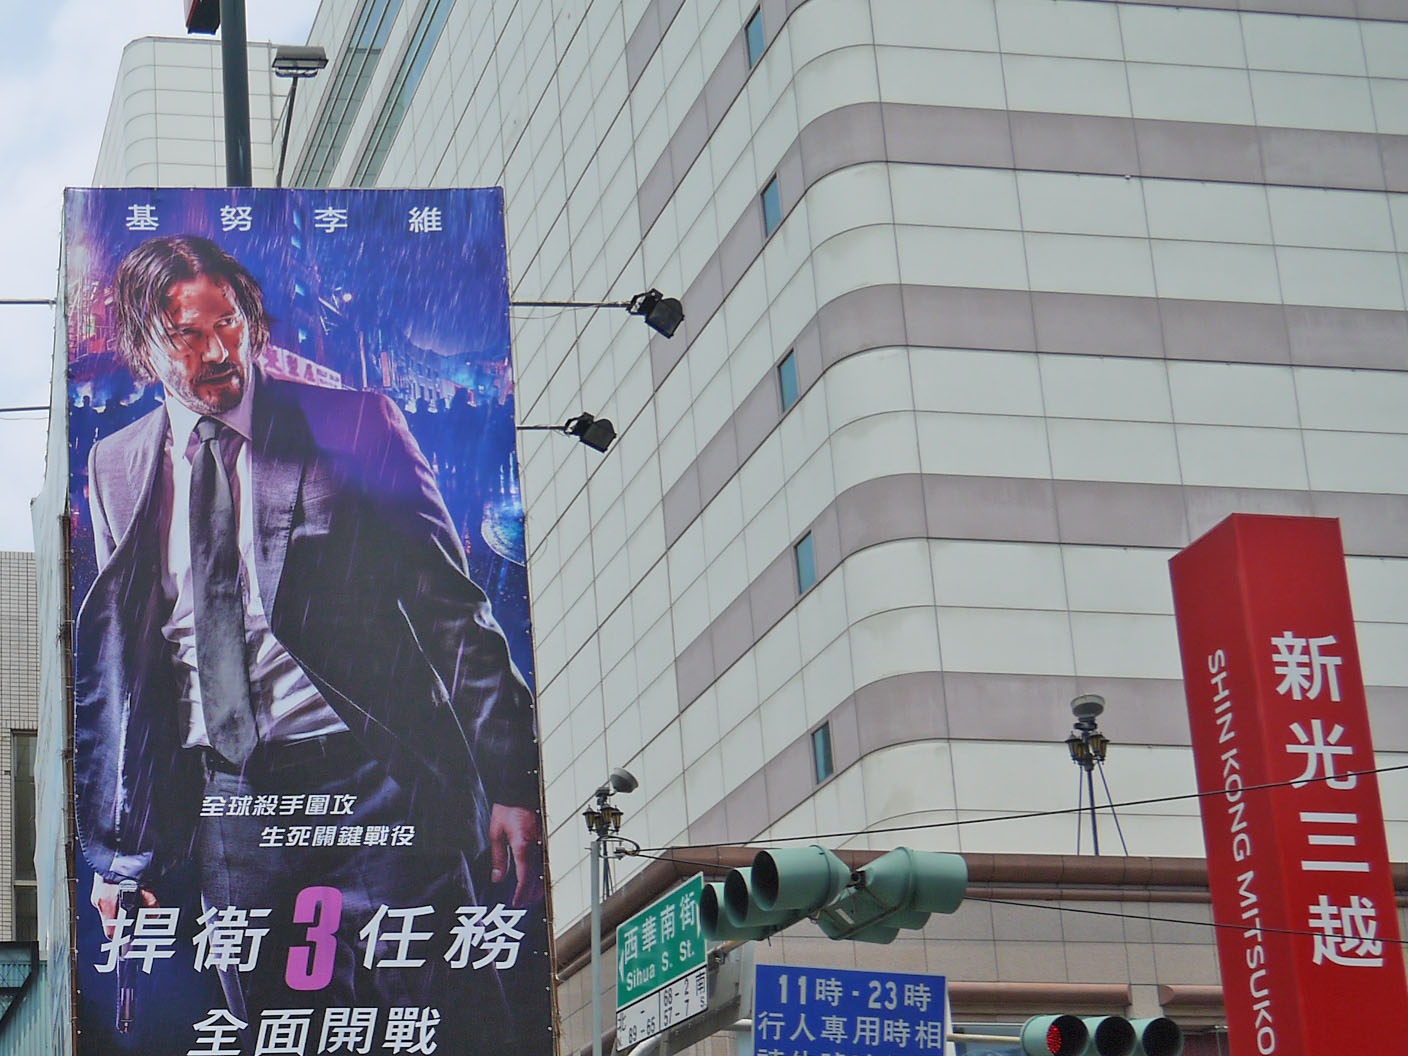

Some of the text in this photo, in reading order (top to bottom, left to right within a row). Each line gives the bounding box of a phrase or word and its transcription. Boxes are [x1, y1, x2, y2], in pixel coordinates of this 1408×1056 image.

[125, 203, 443, 234] 基努李維
[199, 793, 358, 818] 全球殺手圍攻
[1270, 630, 1385, 969] 新光三越
[258, 824, 416, 848] 生死關鍵戰役
[624, 891, 697, 965] 西華南街
[626, 963, 656, 992] Sihua
[679, 938, 695, 962] St.
[757, 1011, 942, 1050] 行人專用時相
